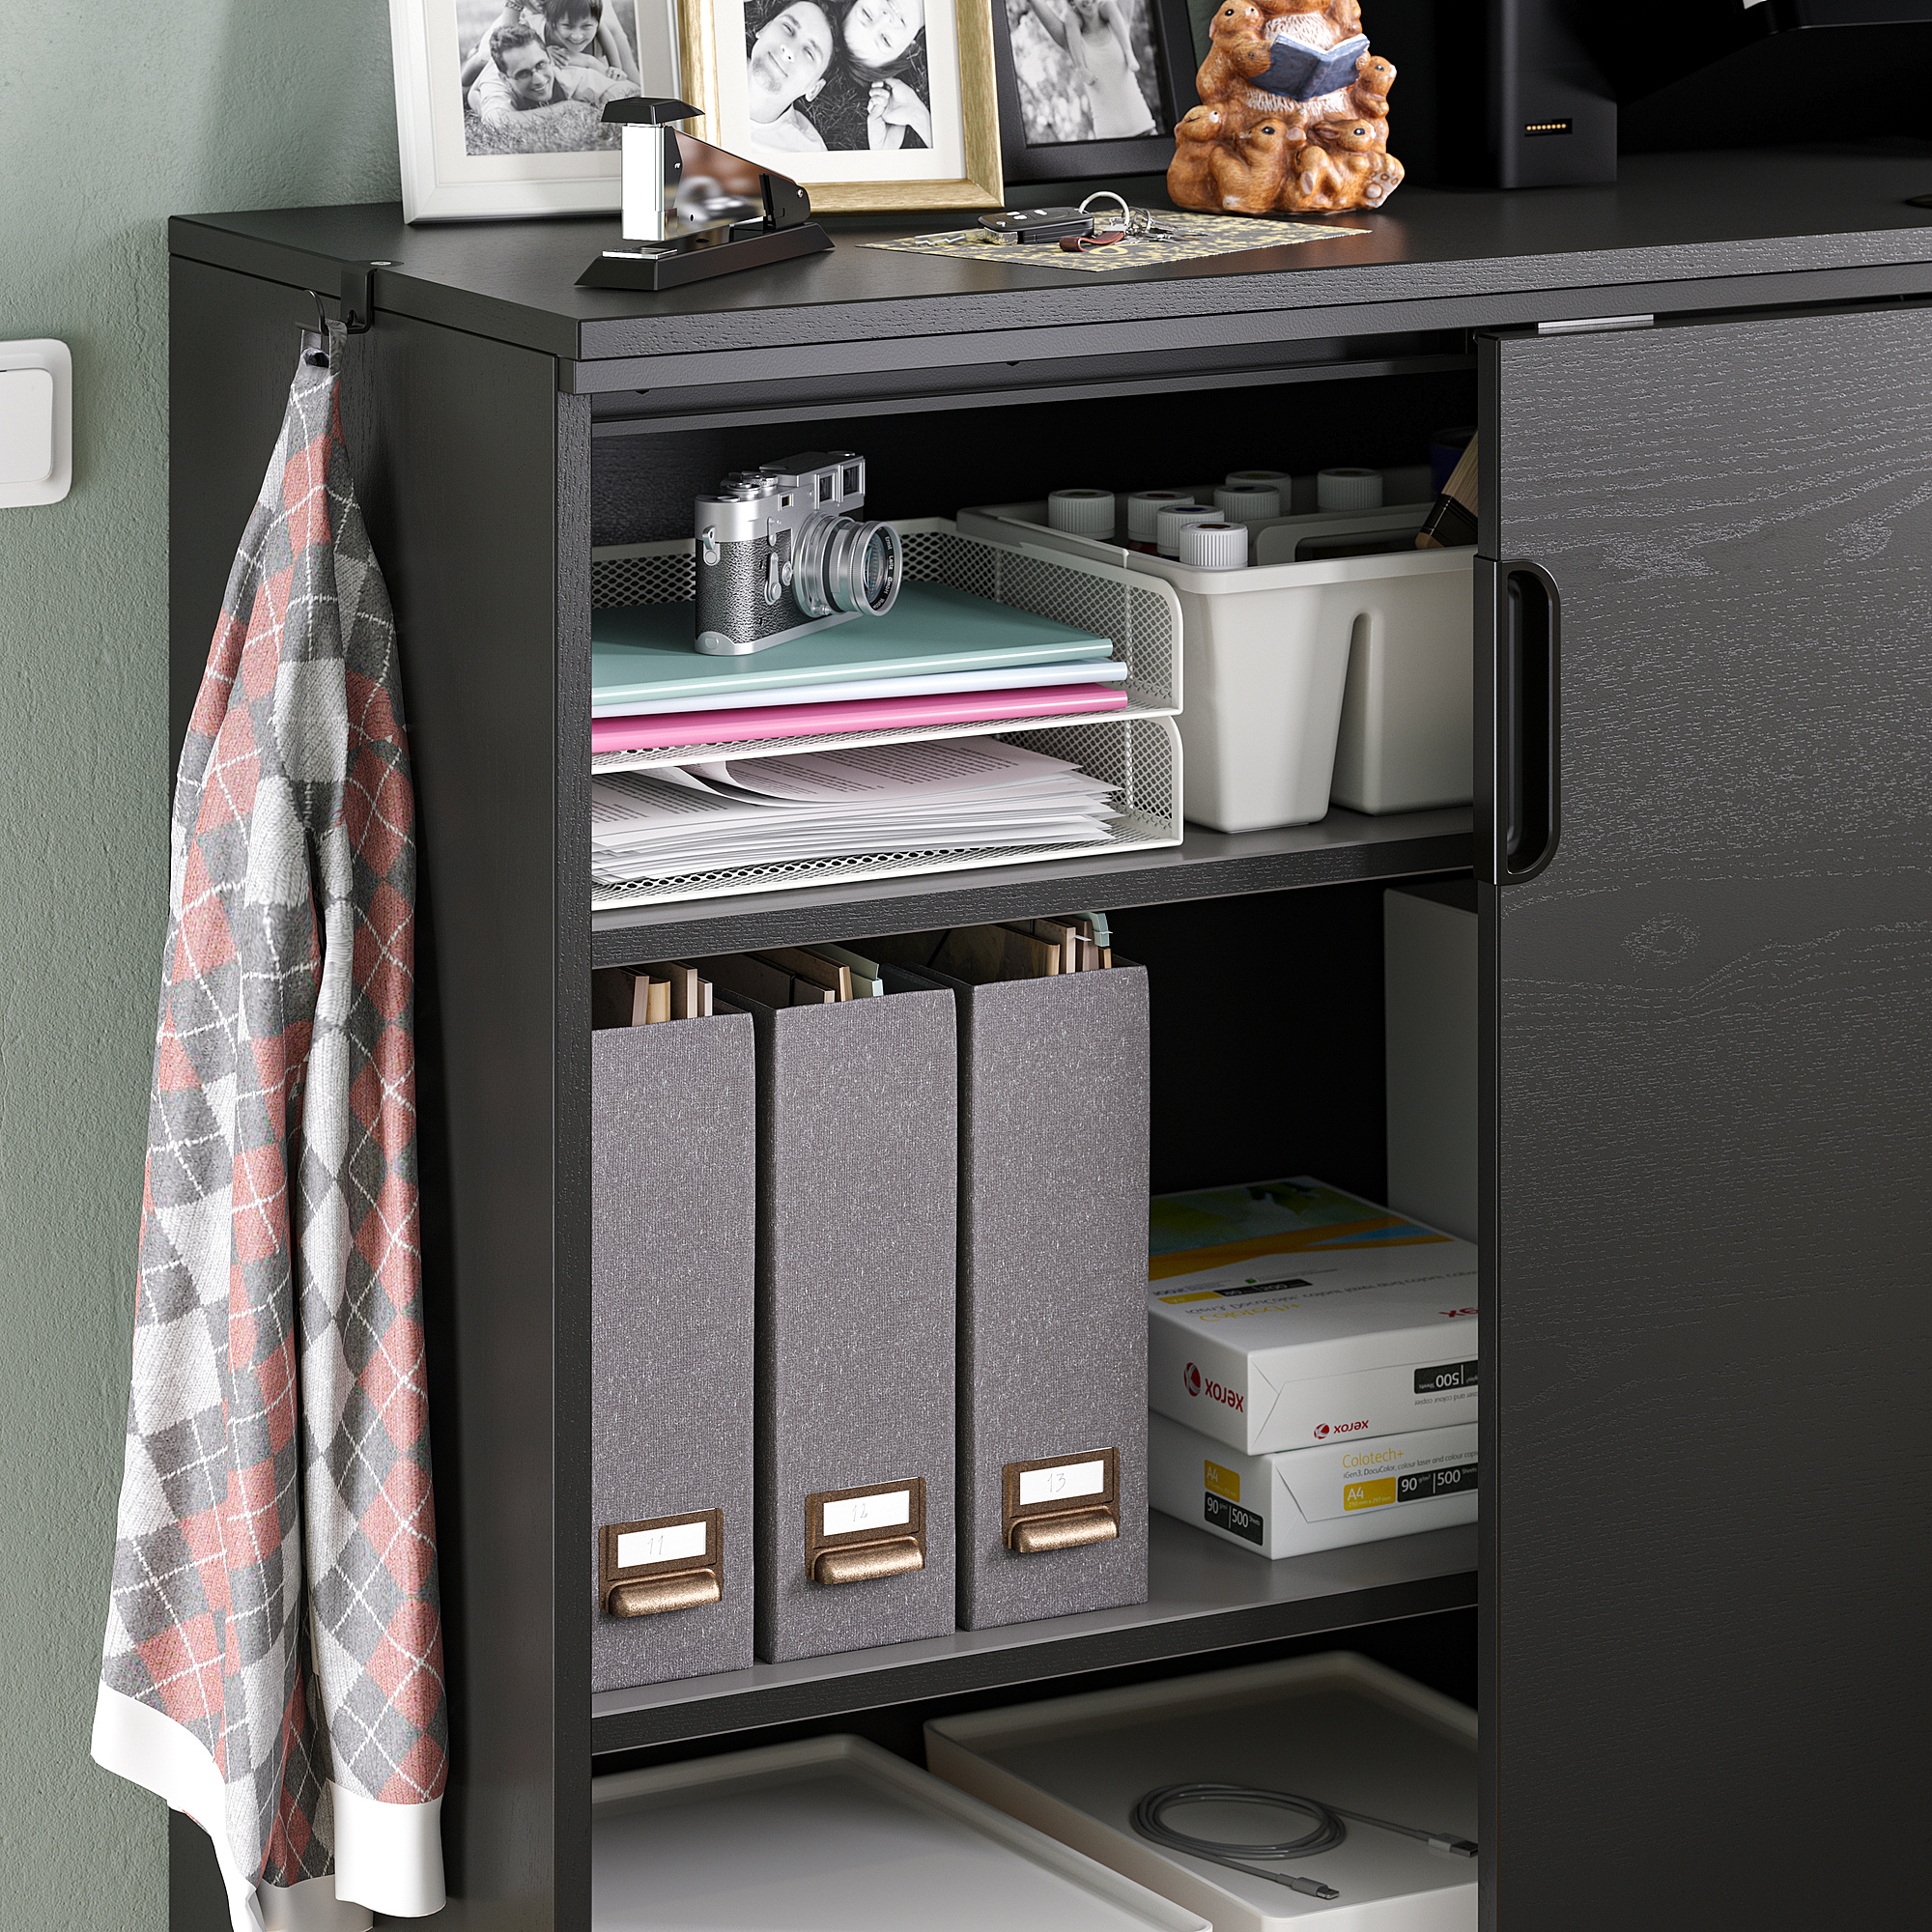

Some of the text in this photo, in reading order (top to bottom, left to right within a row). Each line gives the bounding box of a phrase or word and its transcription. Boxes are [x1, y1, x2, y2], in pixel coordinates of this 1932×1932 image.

[1435, 1372, 1460, 1388] 500
[1205, 1378, 1244, 1412] xerox
[1333, 1419, 1370, 1435] xerox
[1342, 1447, 1404, 1468] Colotech+
[1397, 1461, 1416, 1470] colour
[1416, 1459, 1432, 1467] laser
[1432, 1455, 1444, 1463] and
[1444, 1452, 1463, 1462] colour
[1047, 1473, 1066, 1492] 13
[1207, 1465, 1218, 1483] A4
[1400, 1477, 1418, 1493] 90
[1436, 1468, 1462, 1487] 500
[1347, 1486, 1364, 1501] A4
[852, 1502, 868, 1522] 12
[1207, 1496, 1219, 1515] 90
[1232, 1507, 1249, 1528] 500
[647, 1535, 664, 1555] 11
